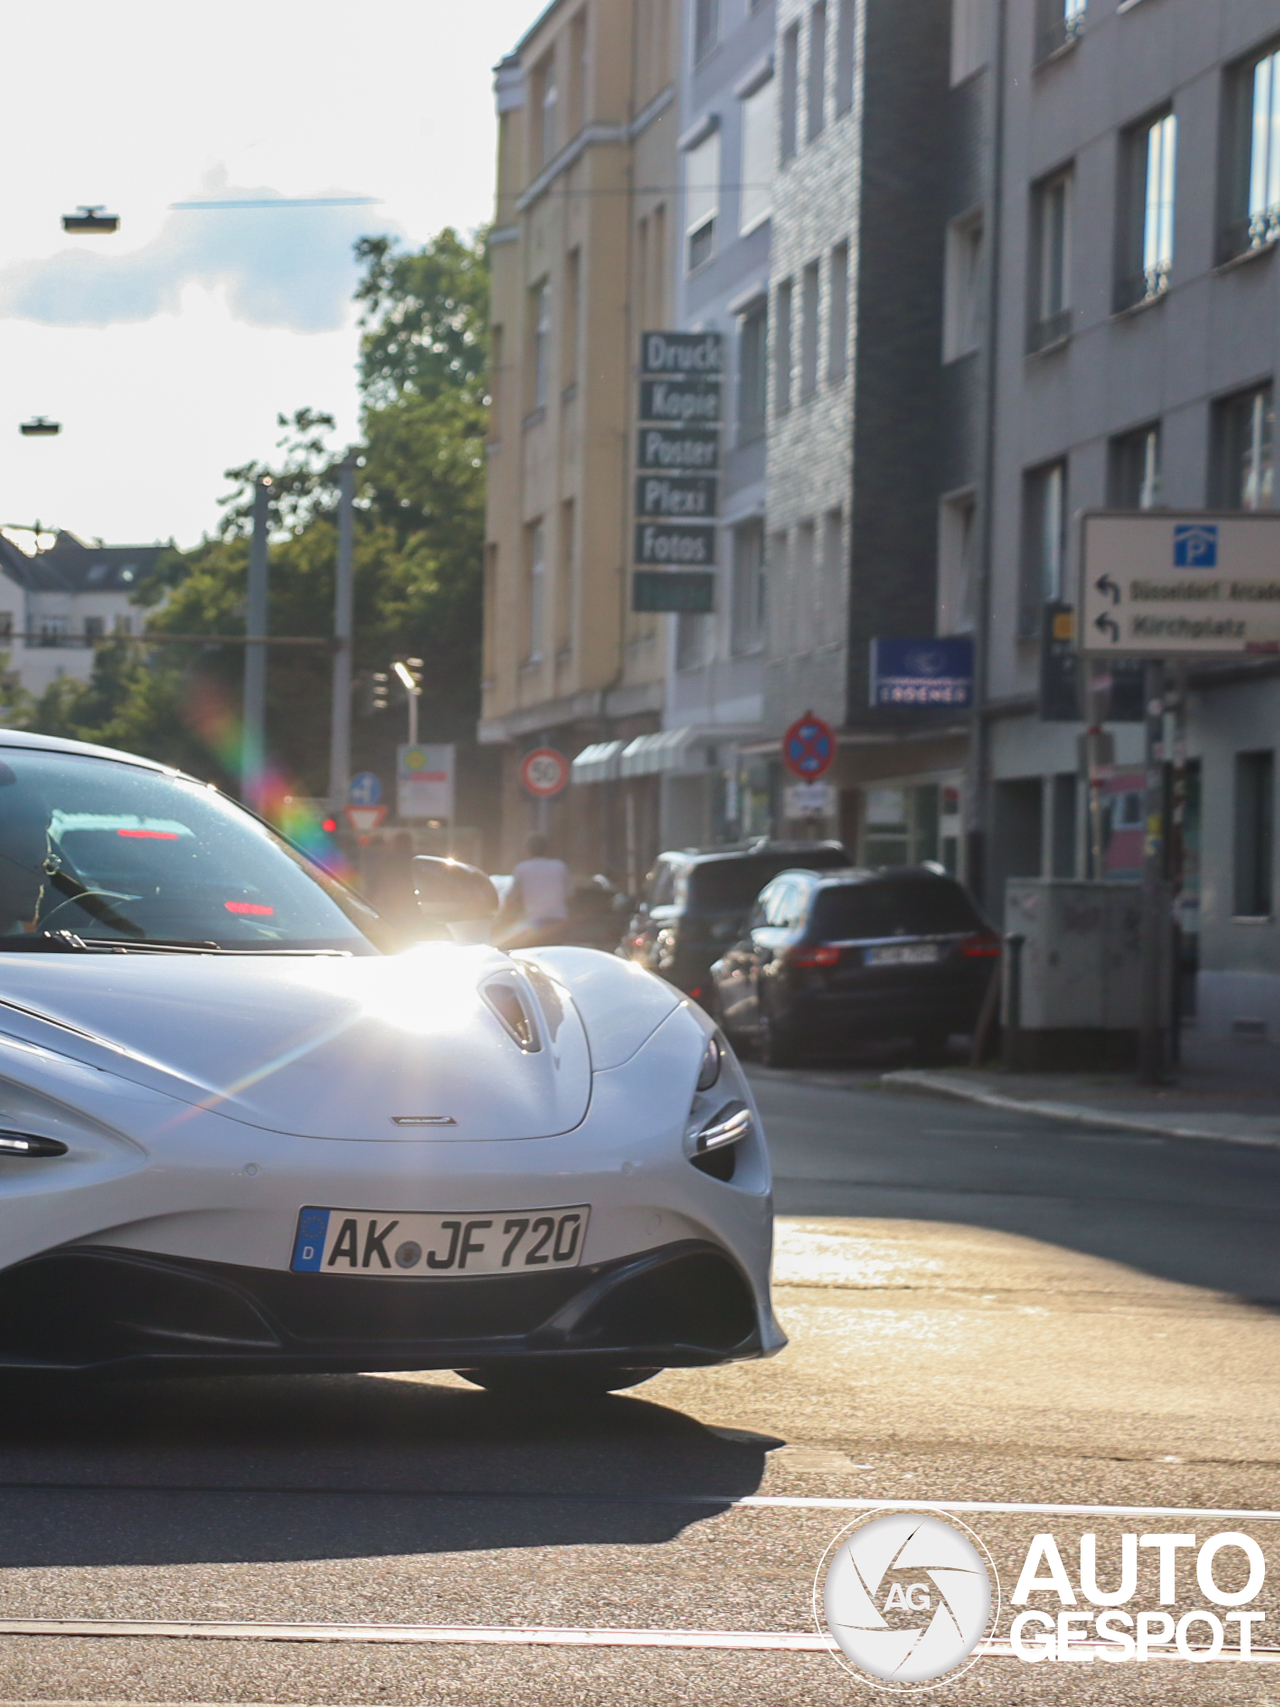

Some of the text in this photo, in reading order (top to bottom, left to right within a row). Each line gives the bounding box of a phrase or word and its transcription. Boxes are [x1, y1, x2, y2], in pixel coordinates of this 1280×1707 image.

[646, 336, 721, 368] Druck
[651, 384, 716, 418] Kopie
[645, 432, 715, 464] Poster
[643, 478, 707, 513] Plexi
[641, 526, 706, 560] Fotos
[301, 1213, 581, 1270] D AK JF 720
